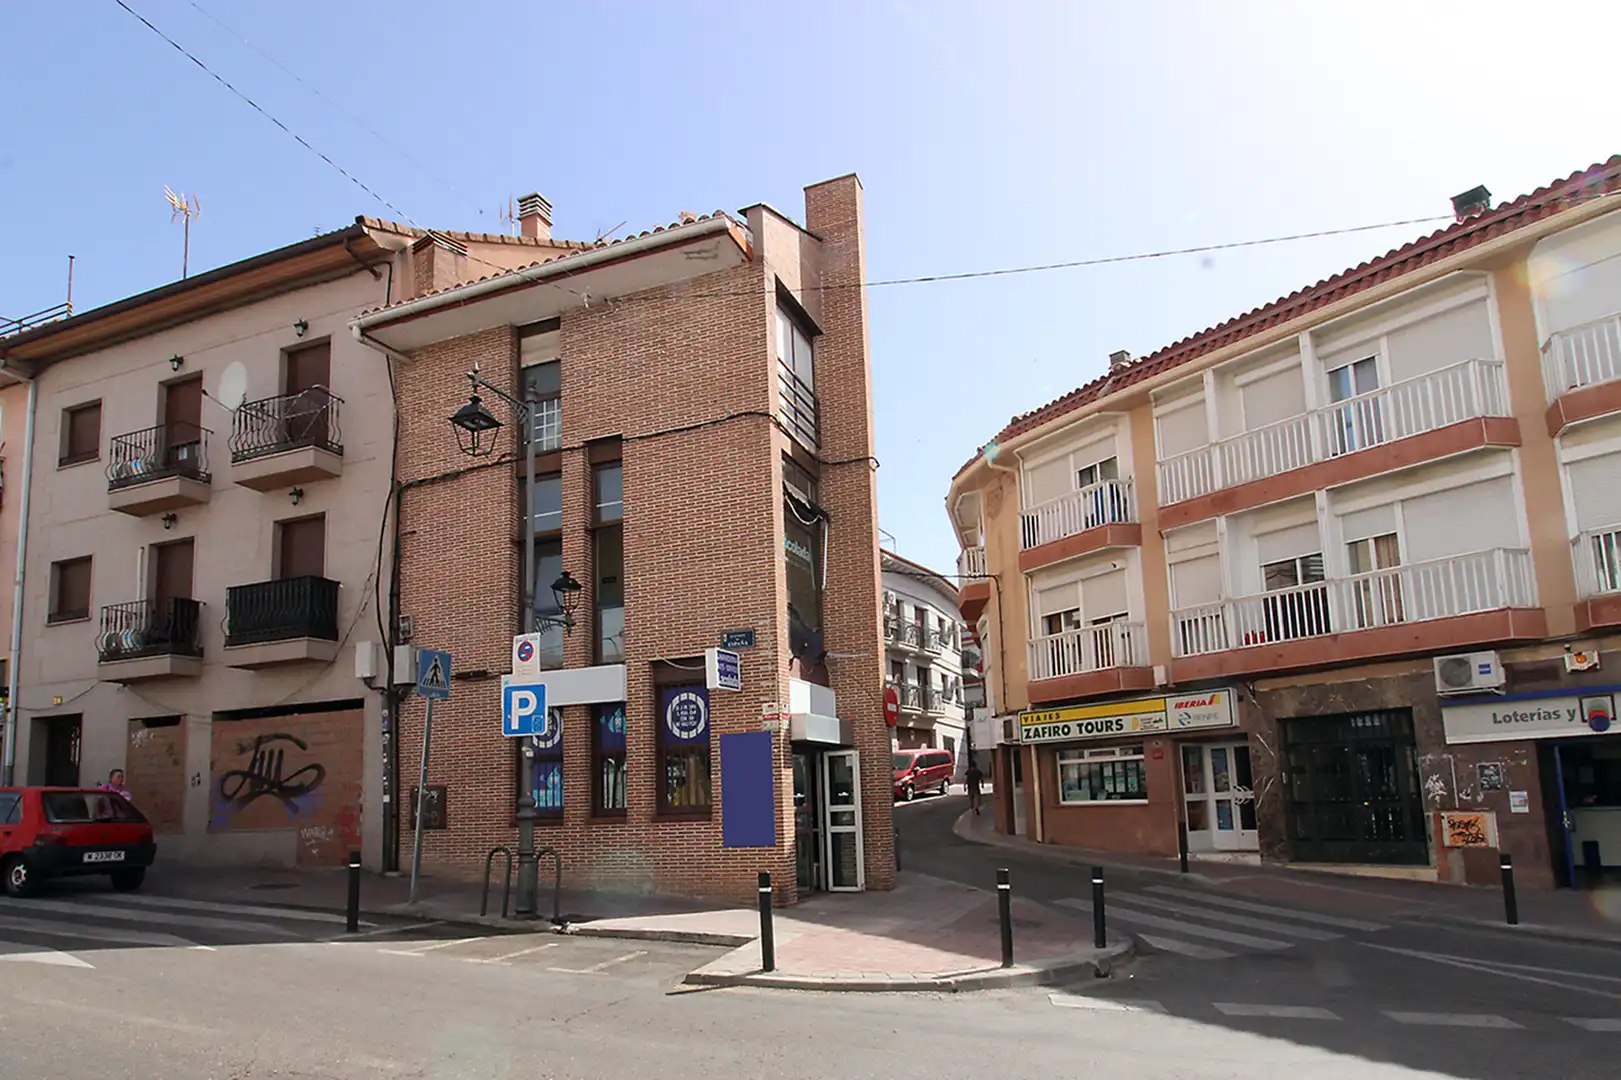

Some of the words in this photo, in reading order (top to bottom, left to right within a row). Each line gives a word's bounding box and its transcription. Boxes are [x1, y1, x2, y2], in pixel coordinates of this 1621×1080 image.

[511, 690, 538, 730] P
[1174, 699, 1207, 709] IBERIA
[1022, 712, 1061, 723] VIAJES
[1492, 708, 1561, 724] Loterías
[1567, 708, 1576, 722] y
[1024, 724, 1071, 739] ZAFIRO
[1077, 719, 1124, 735] TOURS
